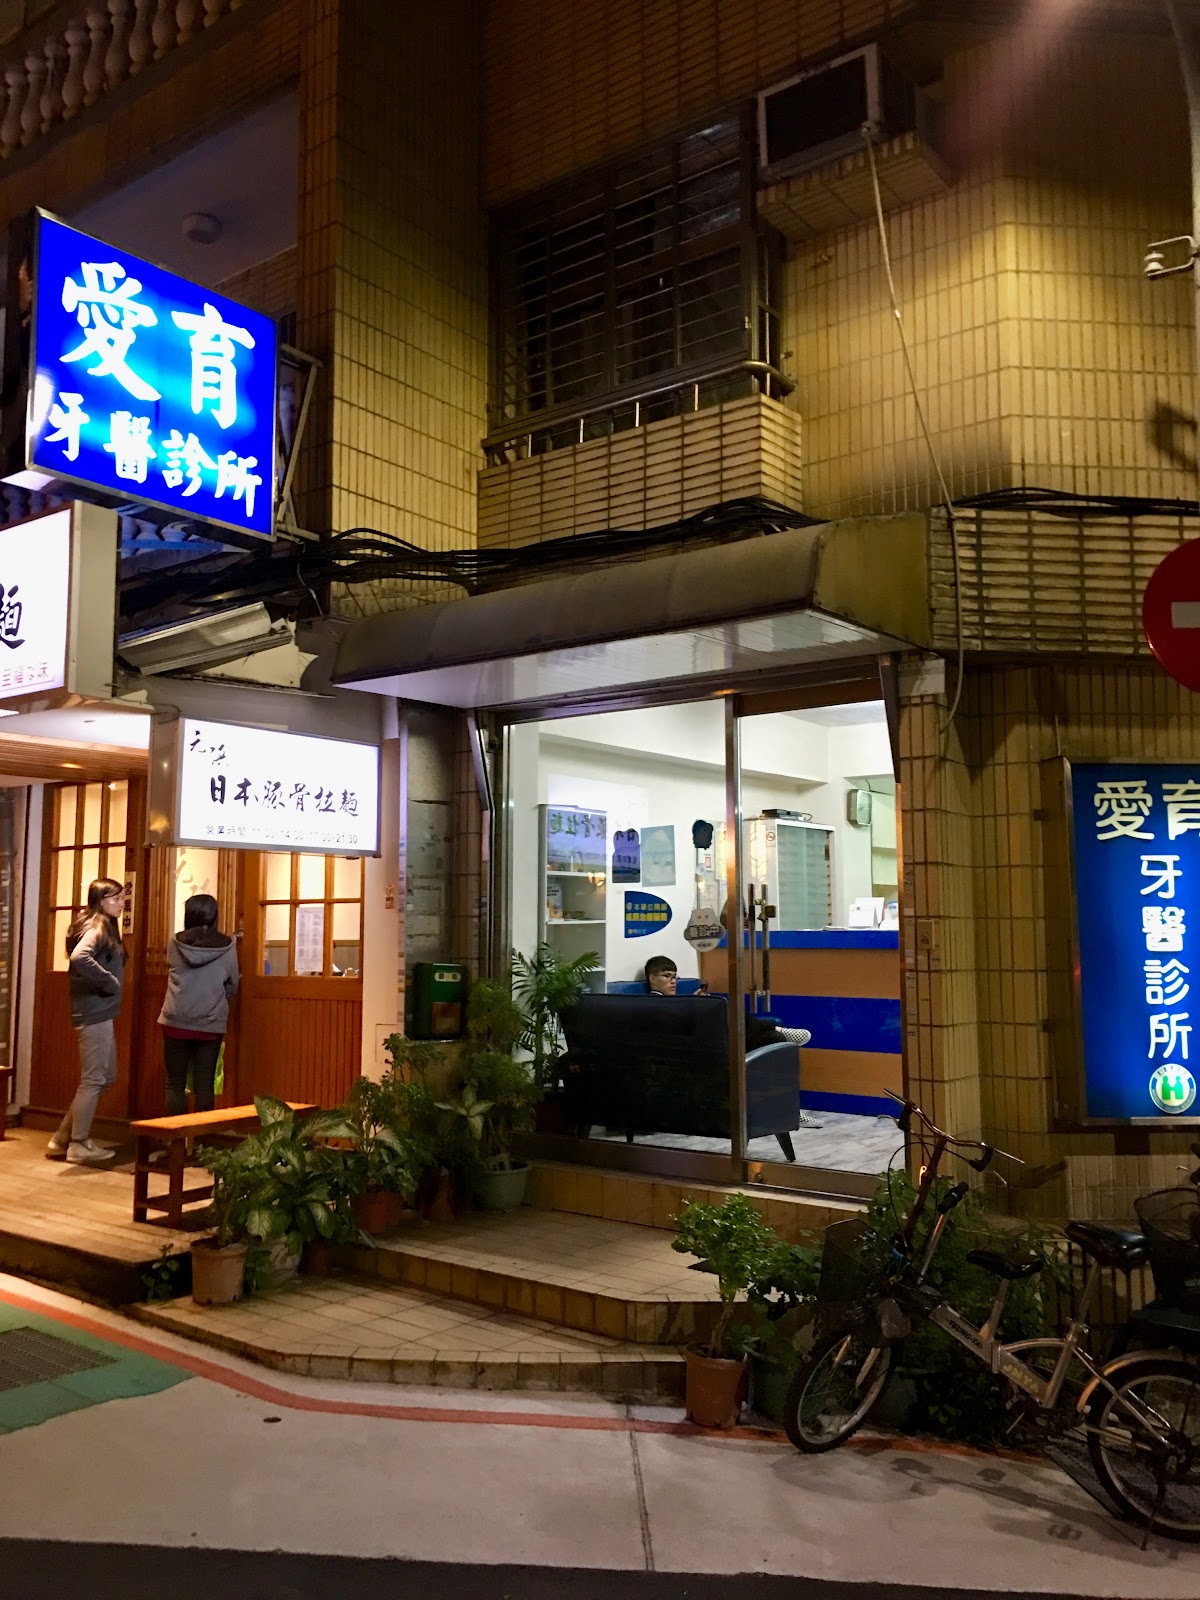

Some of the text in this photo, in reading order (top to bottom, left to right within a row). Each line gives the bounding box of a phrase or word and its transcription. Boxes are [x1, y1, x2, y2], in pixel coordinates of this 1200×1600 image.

[59, 261, 256, 429] 愛育
[44, 391, 263, 518] 牙醫診所
[1093, 779, 1200, 841] 愛育
[1139, 853, 1193, 1061] 牙醫診所
